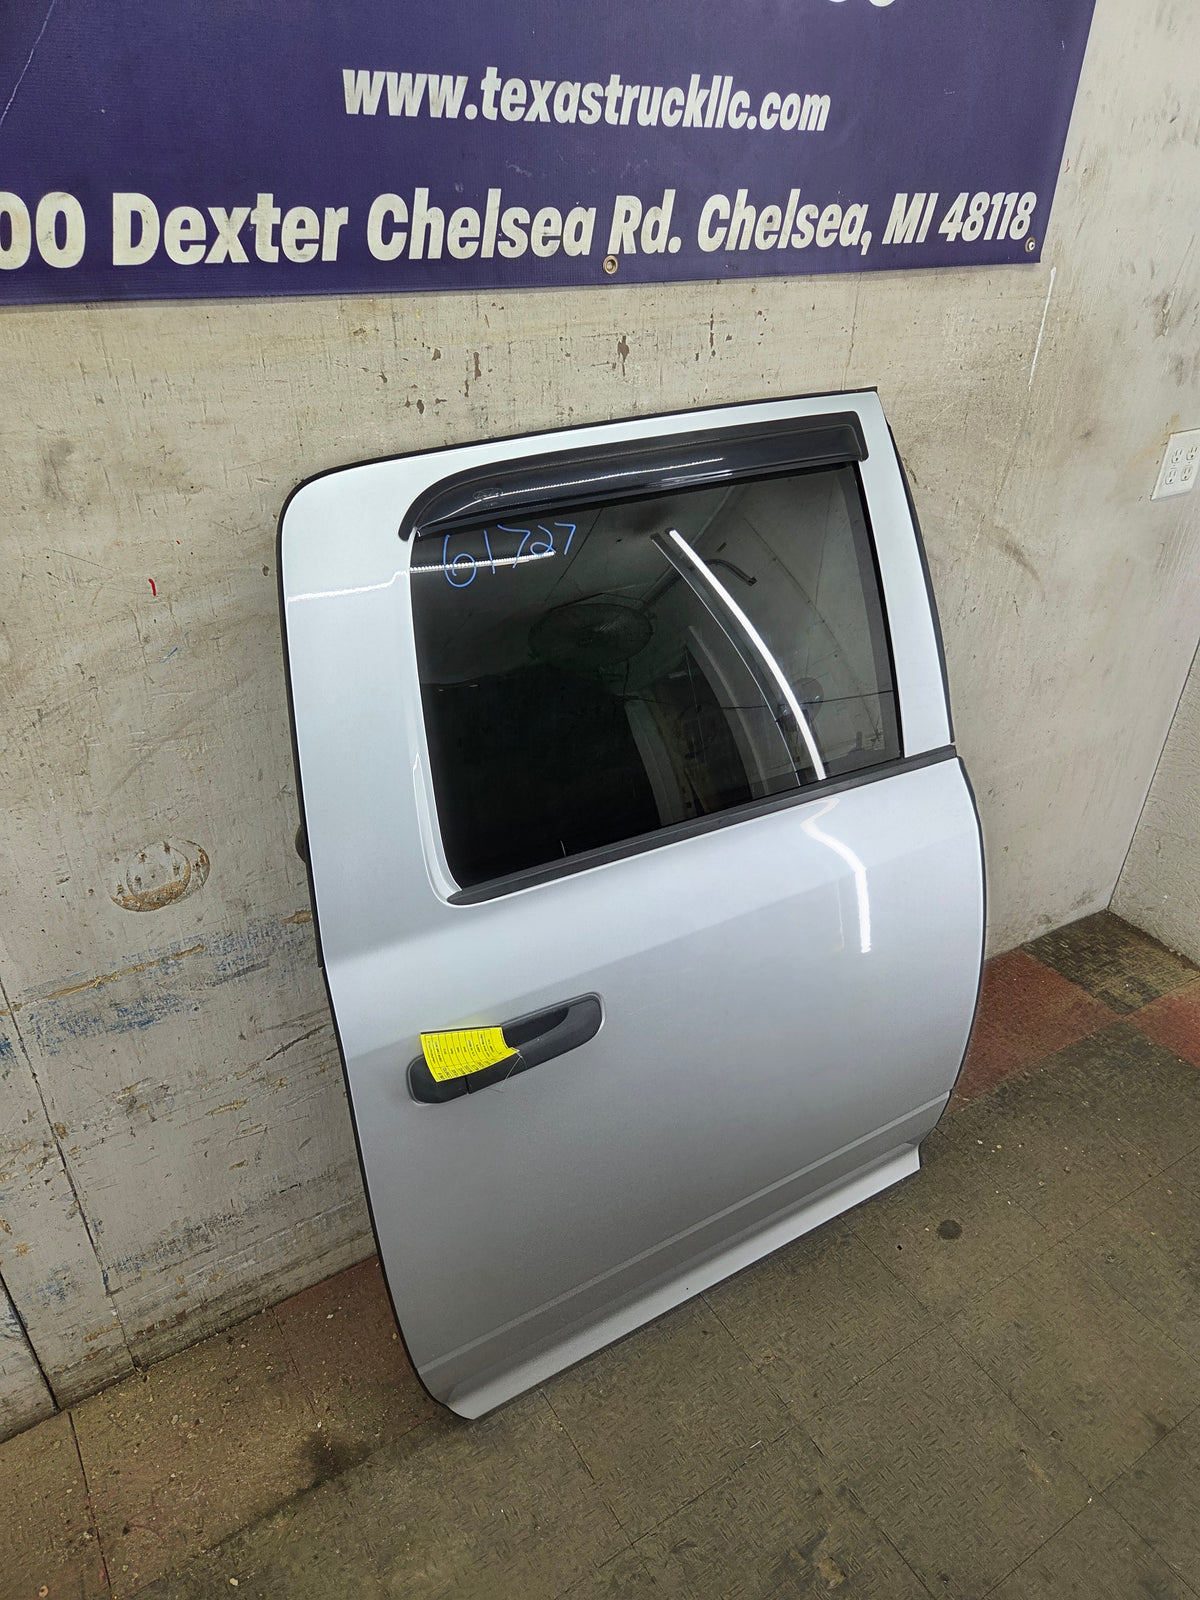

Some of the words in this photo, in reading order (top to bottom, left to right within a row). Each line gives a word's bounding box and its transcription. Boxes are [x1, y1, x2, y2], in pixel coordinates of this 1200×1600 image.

[342, 66, 831, 132] www.texastruckllc.com
[112, 192, 349, 266] Dexter
[366, 187, 597, 261] Chelsea
[607, 188, 682, 255] Rd.
[697, 188, 873, 256] Chelsea,
[881, 192, 939, 245] MI
[937, 191, 1037, 242] 48118
[442, 522, 577, 588] 61727
